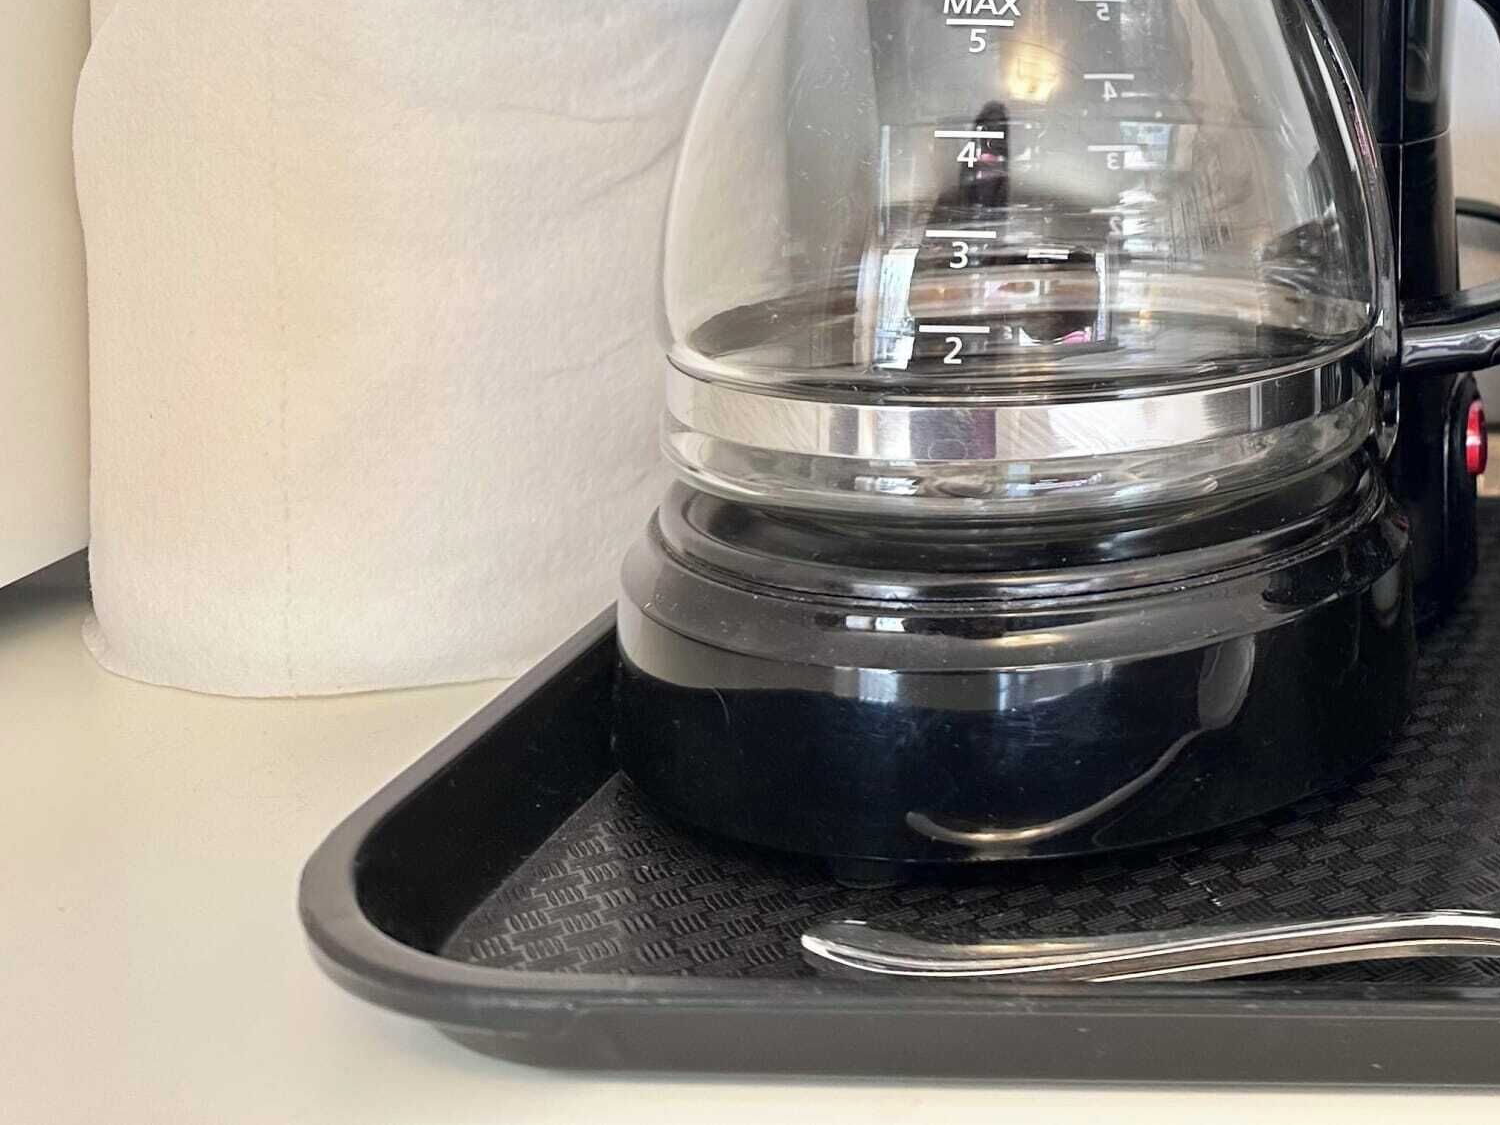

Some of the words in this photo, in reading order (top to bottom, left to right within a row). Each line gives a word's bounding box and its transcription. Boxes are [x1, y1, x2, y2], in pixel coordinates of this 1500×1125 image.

[969, 29, 987, 53] 5
[957, 142, 978, 168] 4
[950, 242, 969, 269] 3
[943, 336, 963, 365] 2
